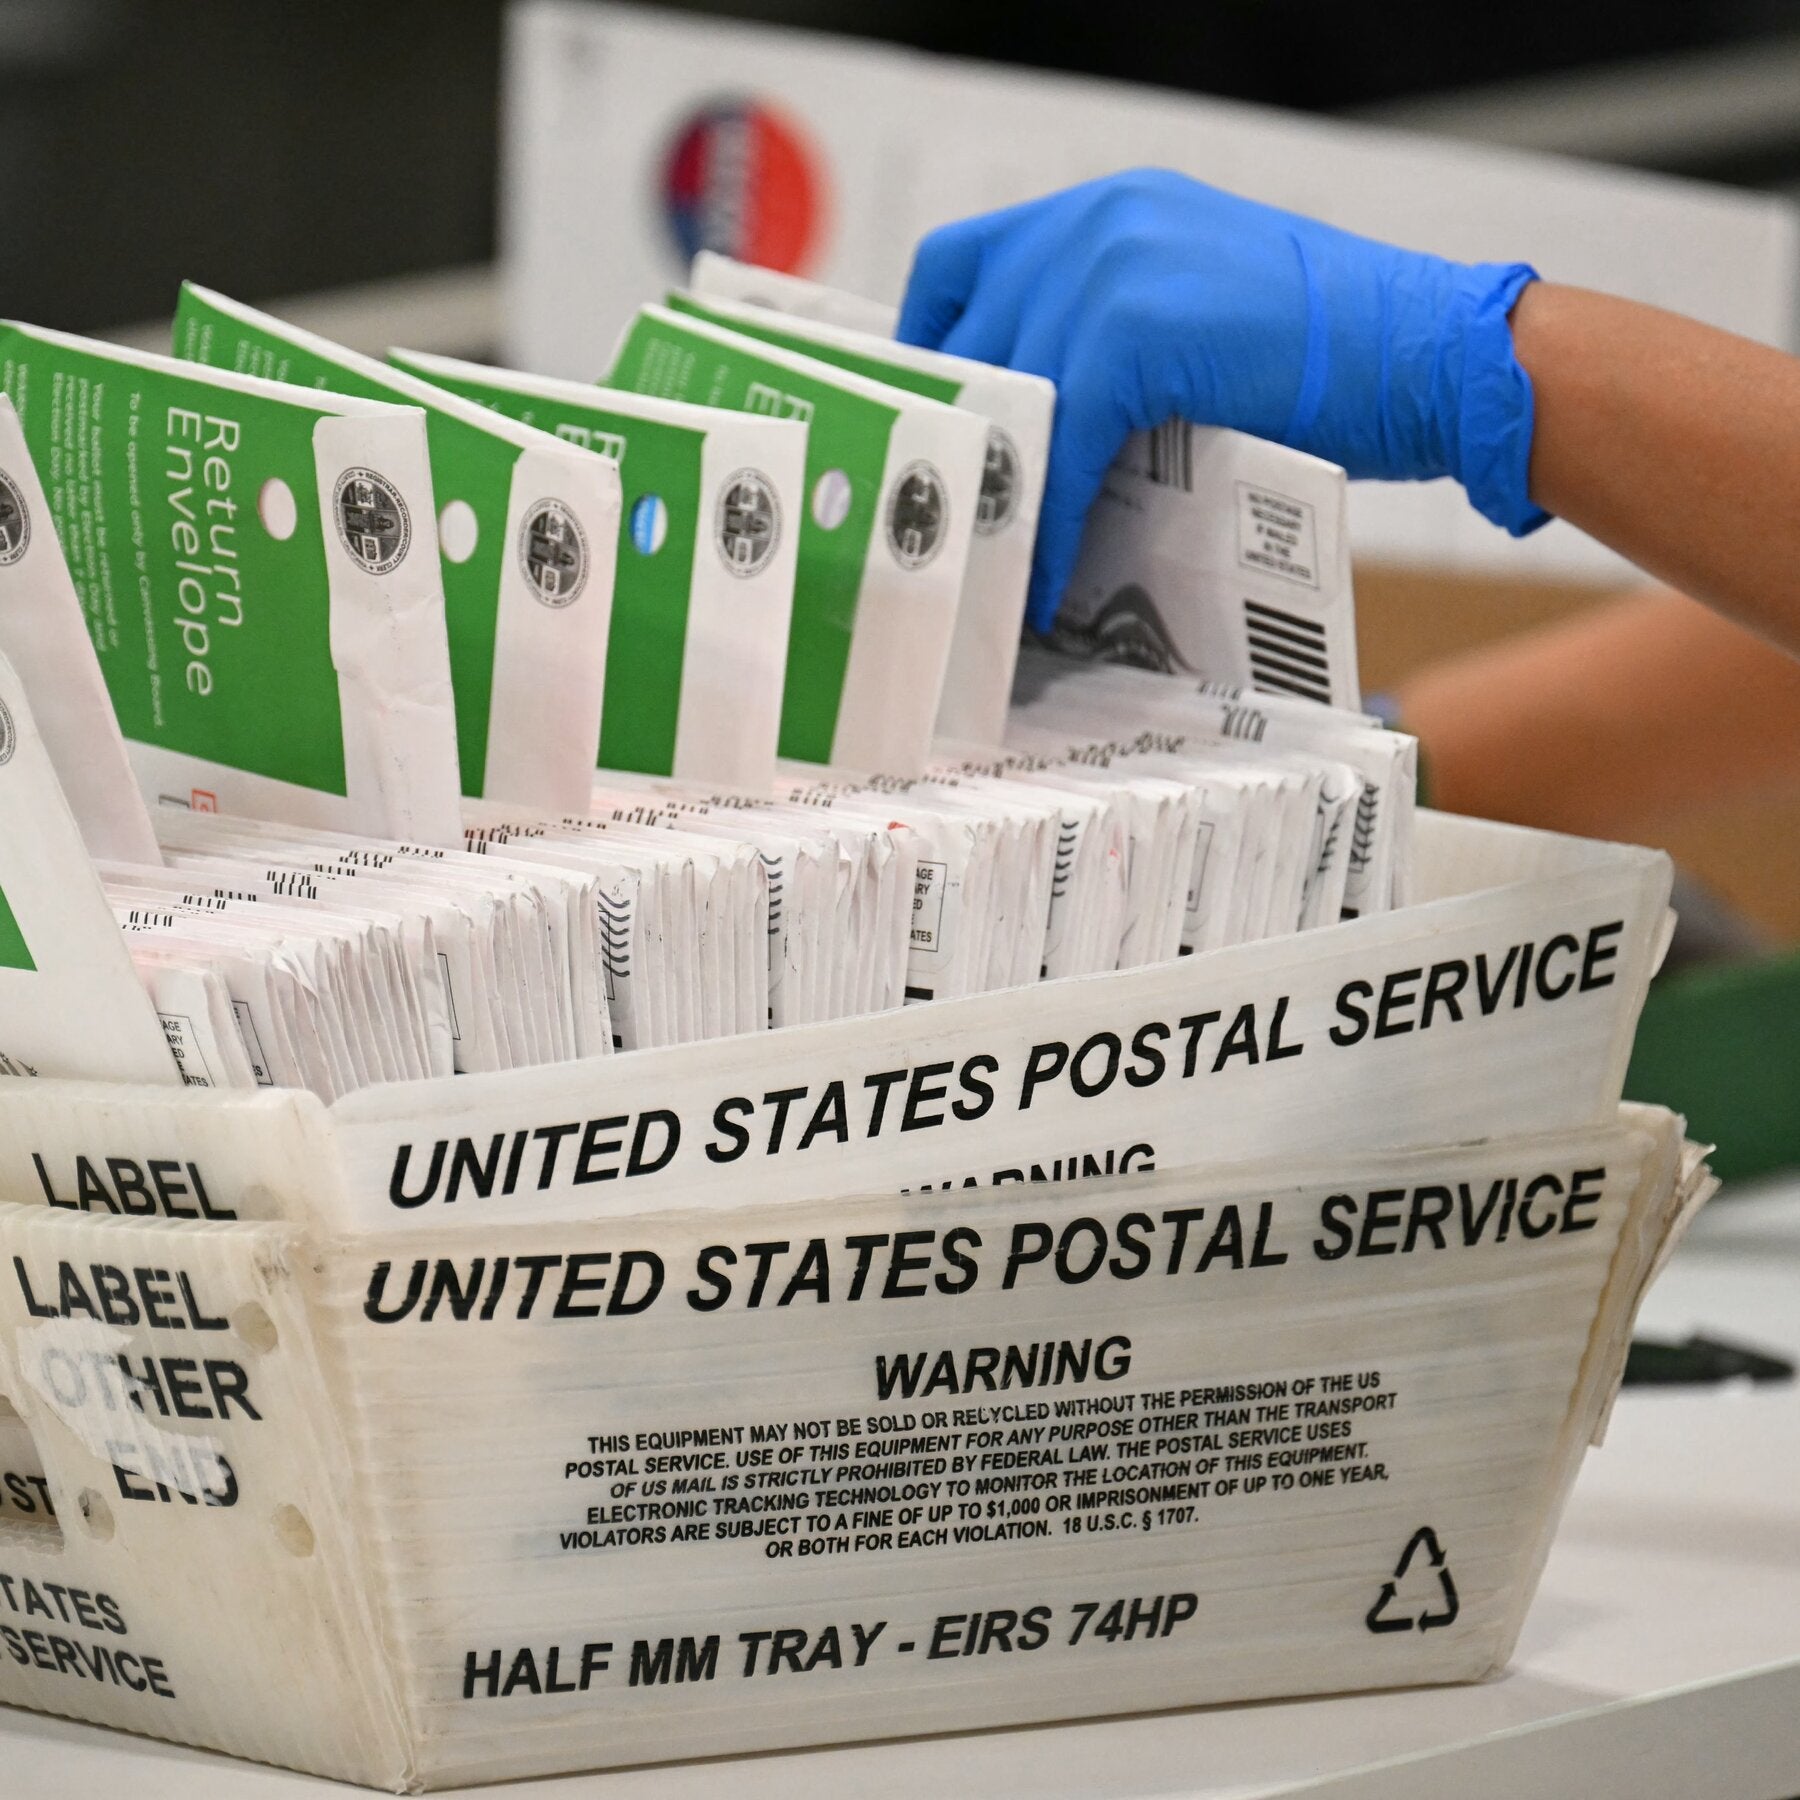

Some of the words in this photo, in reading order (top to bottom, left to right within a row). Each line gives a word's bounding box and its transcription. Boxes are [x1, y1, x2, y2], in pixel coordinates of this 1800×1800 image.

[165, 406, 213, 697] Envelope
[204, 414, 243, 627] Return
[390, 1110, 680, 1208] UNITED
[705, 1055, 998, 1163] STATES
[1019, 997, 1303, 1110] POSTAL
[1329, 921, 1623, 1046] SERVICE
[31, 1152, 237, 1220] LABEL
[364, 1251, 664, 1323] UNITED
[687, 1227, 982, 1312] STATES
[1002, 1202, 1288, 1290] POSTAL
[1313, 1166, 1606, 1261] SERVICE
[13, 1256, 230, 1330] LABEL
[876, 1335, 1132, 1400] WARNING
[566, 1459, 639, 1478] POSTAL
[645, 1452, 729, 1474] SERVICE.
[736, 1449, 773, 1467] USE
[779, 1447, 804, 1464] OF
[809, 1443, 849, 1462] THIS
[855, 1434, 962, 1458] EQUIPMENT
[966, 1431, 1004, 1449] FOR
[1006, 1427, 1045, 1446] ANY
[1048, 1419, 1134, 1442] PURPOSE
[1139, 1413, 1199, 1434] OTHER
[1204, 1408, 1251, 1428] THAN
[1256, 1404, 1289, 1423] THE
[1294, 1393, 1397, 1418] TRANSPORT
[588, 1435, 630, 1454] THIS
[636, 1427, 744, 1450] EQUIPMENT
[750, 1424, 788, 1443] MAY
[794, 1421, 831, 1440] NOT
[837, 1418, 861, 1437] BE
[867, 1414, 916, 1434] SOLD
[921, 1412, 948, 1429] OR
[953, 1403, 1050, 1426] RECYCLED
[1054, 1395, 1135, 1418] WITHOUT
[1141, 1391, 1175, 1410] THE
[1180, 1381, 1287, 1407] PERMISSION
[1291, 1378, 1315, 1396] OF
[1320, 1374, 1353, 1393] THE
[1358, 1371, 1380, 1389] US
[0, 1472, 55, 1516] ST
[587, 1499, 707, 1524] ELECTRONIC
[713, 1492, 809, 1515] TRACKING
[815, 1482, 942, 1507] TECHNOLOGY
[946, 1480, 970, 1497] TO
[975, 1472, 1057, 1495] MONITOR
[1063, 1468, 1097, 1487] THE
[1102, 1460, 1191, 1484] LOCATION
[1195, 1457, 1220, 1475] OF
[1225, 1453, 1262, 1472] THIS
[1267, 1442, 1367, 1468] EQUIPMENT.
[611, 1482, 637, 1498] OF
[642, 1480, 667, 1496] US
[672, 1477, 716, 1494] MAIL
[721, 1475, 739, 1491] IS
[744, 1467, 833, 1489] STRICTLY
[836, 1458, 946, 1482] PROHIBITED
[952, 1455, 977, 1473] BY
[981, 1448, 1063, 1471] FEDERAL
[1069, 1444, 1110, 1463] LAW.
[1116, 1440, 1151, 1459] THE
[1155, 1434, 1223, 1455] POSTAL
[1228, 1425, 1302, 1449] SERVICE
[1307, 1420, 1351, 1441] USES
[560, 1526, 666, 1549] VIOLATORS
[671, 1523, 710, 1542] ARE
[715, 1517, 801, 1539] SUBJECT
[806, 1514, 831, 1532] TO
[834, 1513, 848, 1530] A
[852, 1509, 893, 1529] FINE
[898, 1507, 923, 1525] OF
[928, 1505, 953, 1522] UP
[958, 1502, 982, 1520] TO
[987, 1497, 1040, 1519] $1,000
[1045, 1495, 1071, 1512] OR
[1076, 1481, 1211, 1510] IMPRISONMENT
[1214, 1479, 1239, 1496] OF
[1243, 1476, 1267, 1493] UP
[1272, 1473, 1294, 1491] TO
[1298, 1469, 1335, 1488] ONE
[1340, 1463, 1389, 1484] YEAR,
[765, 1541, 793, 1558] OR
[798, 1536, 849, 1556] BOTH
[855, 1533, 892, 1552] FOR
[898, 1528, 948, 1548] EACH
[953, 1520, 1052, 1543] VIOLATION.
[1063, 1517, 1081, 1534] 18
[1087, 1512, 1137, 1532] U.S.C.
[1158, 1506, 1198, 1525] 1707.
[0, 1624, 176, 1699] SERVICE
[463, 1643, 613, 1699] HALF
[629, 1635, 720, 1687] MM
[738, 1622, 887, 1677] TRAY
[927, 1606, 1052, 1659] EIRS
[1068, 1593, 1198, 1646] 74HP
